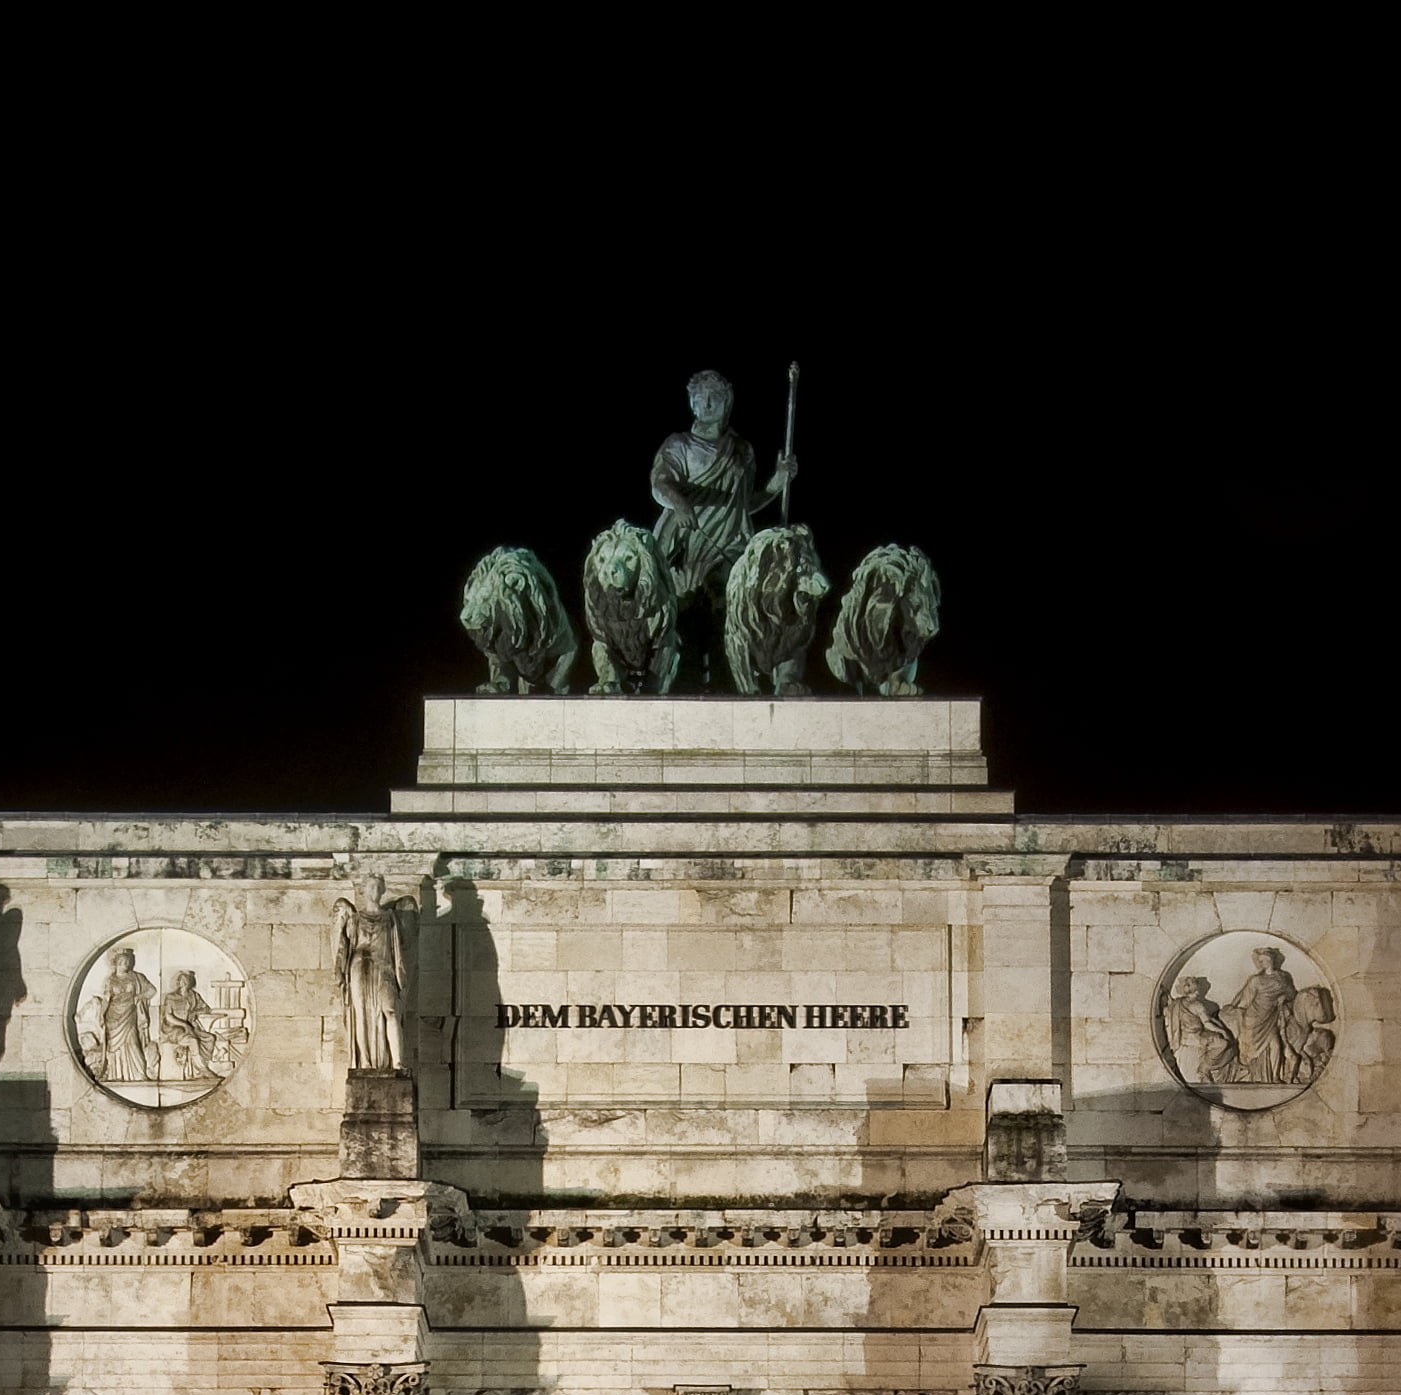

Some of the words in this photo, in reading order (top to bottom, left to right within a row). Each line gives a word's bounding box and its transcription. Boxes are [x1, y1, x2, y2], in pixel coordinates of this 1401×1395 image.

[494, 1003, 572, 1029] DEM
[575, 1003, 799, 1030] BAYERISCHEN
[802, 1004, 911, 1030] HEERE
